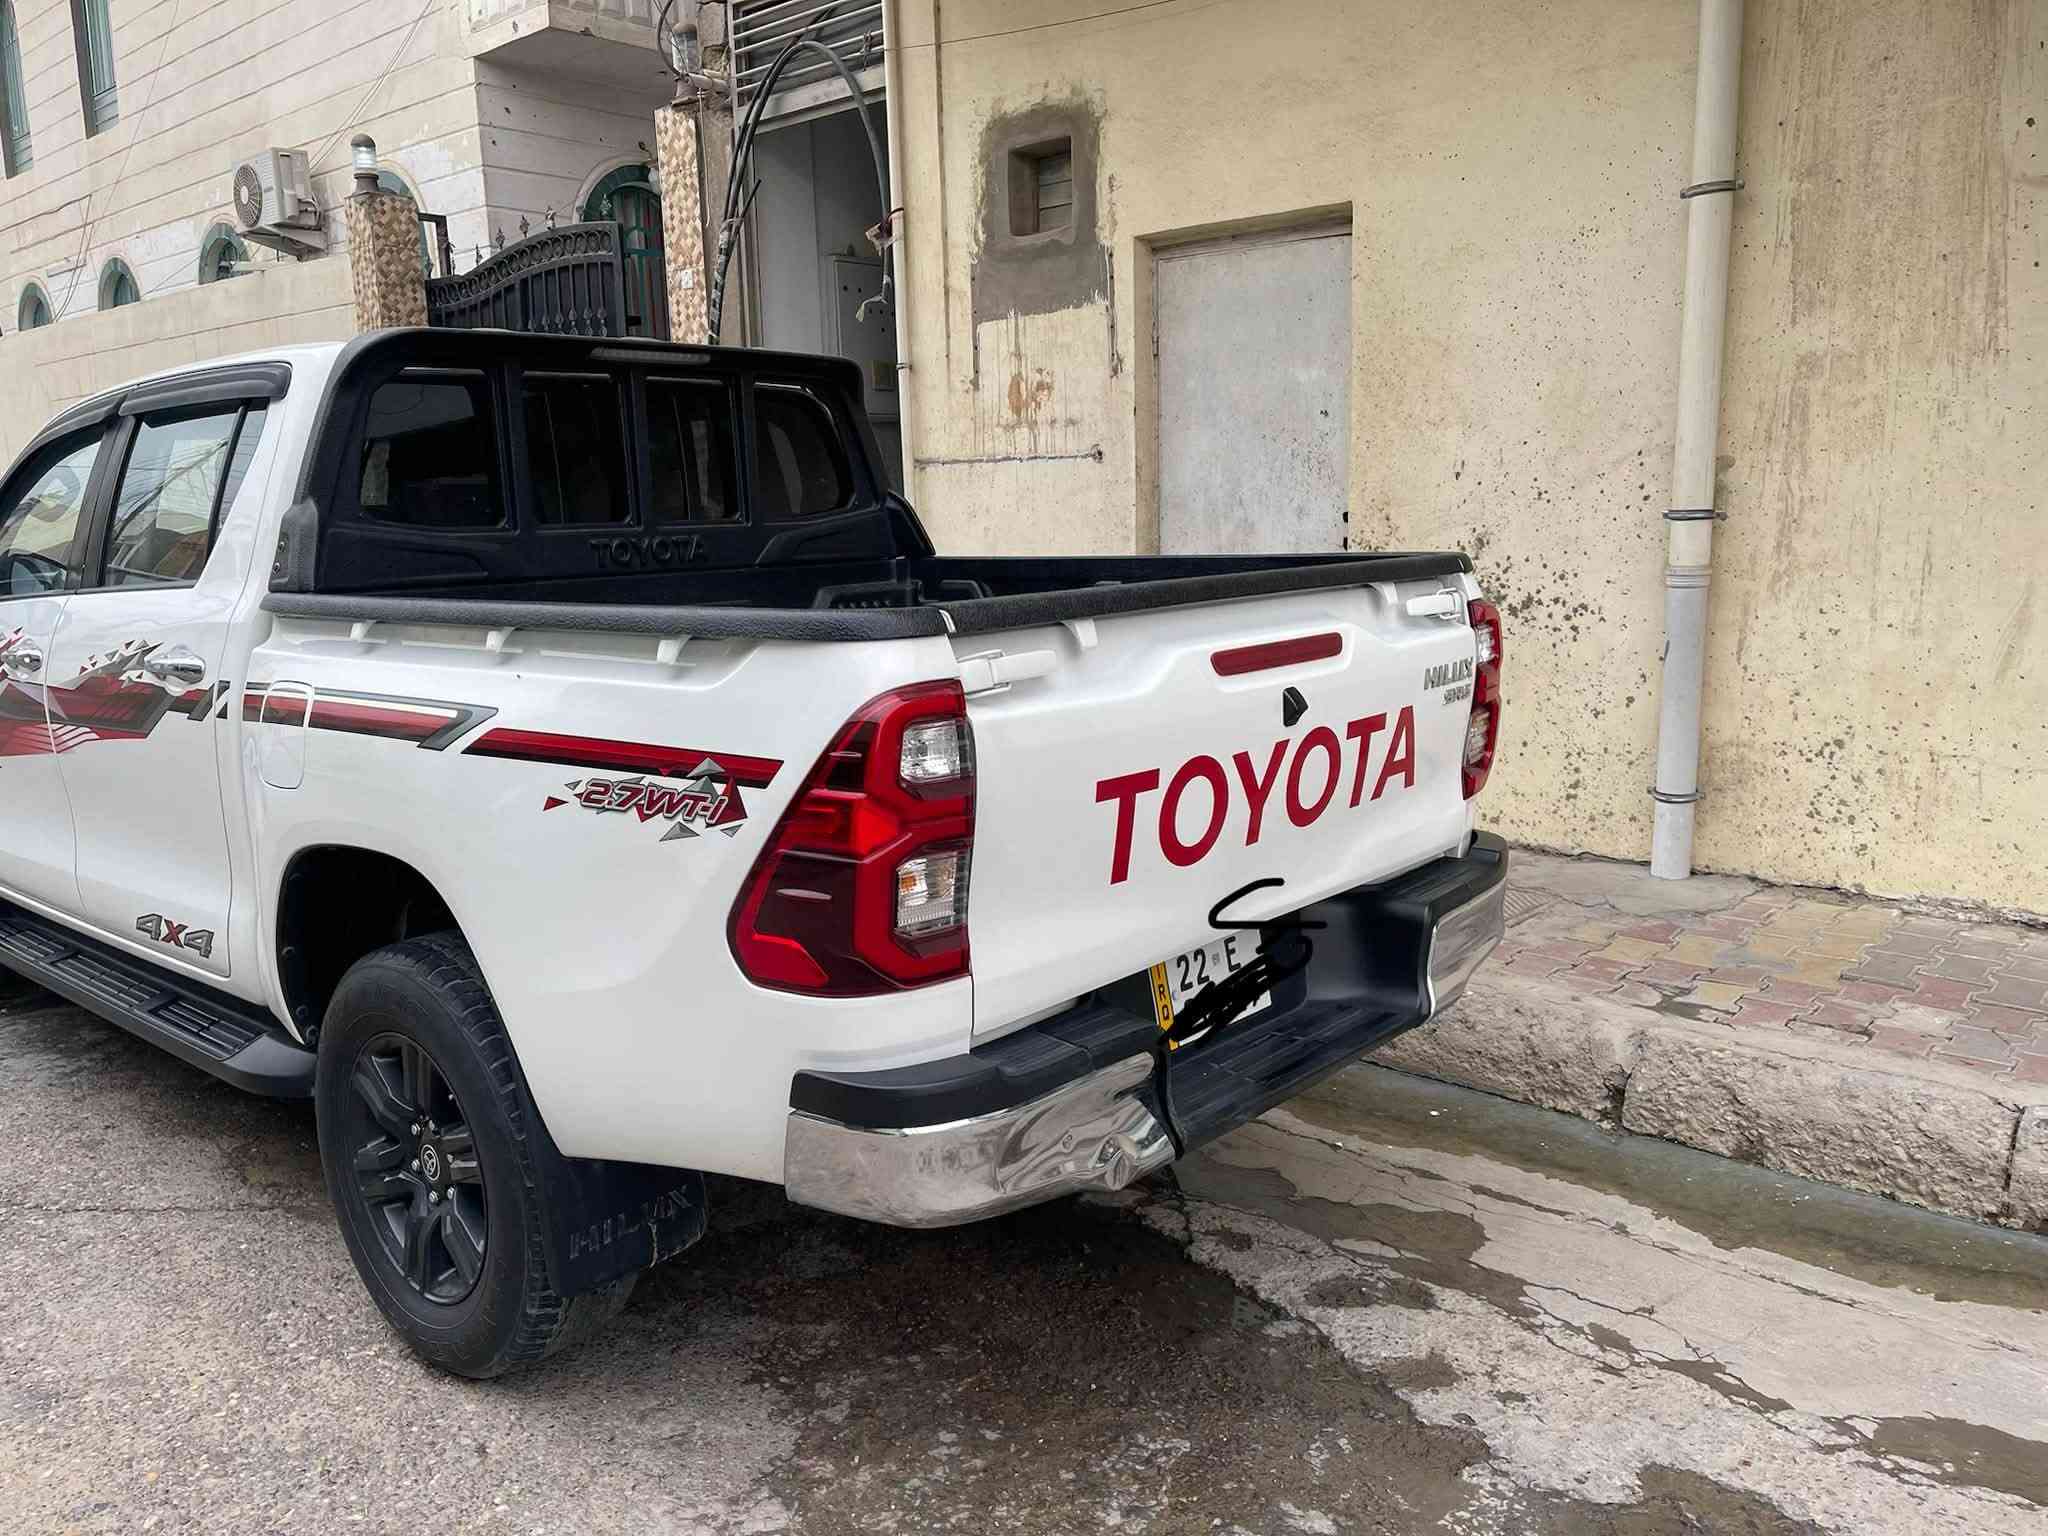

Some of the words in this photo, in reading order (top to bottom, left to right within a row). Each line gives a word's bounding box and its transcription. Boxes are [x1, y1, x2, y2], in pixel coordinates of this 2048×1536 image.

[588, 533, 706, 567] TOYOTA
[1096, 704, 1415, 884] TOYOTA
[1177, 948, 1210, 992] 22
[1224, 936, 1241, 972] E
